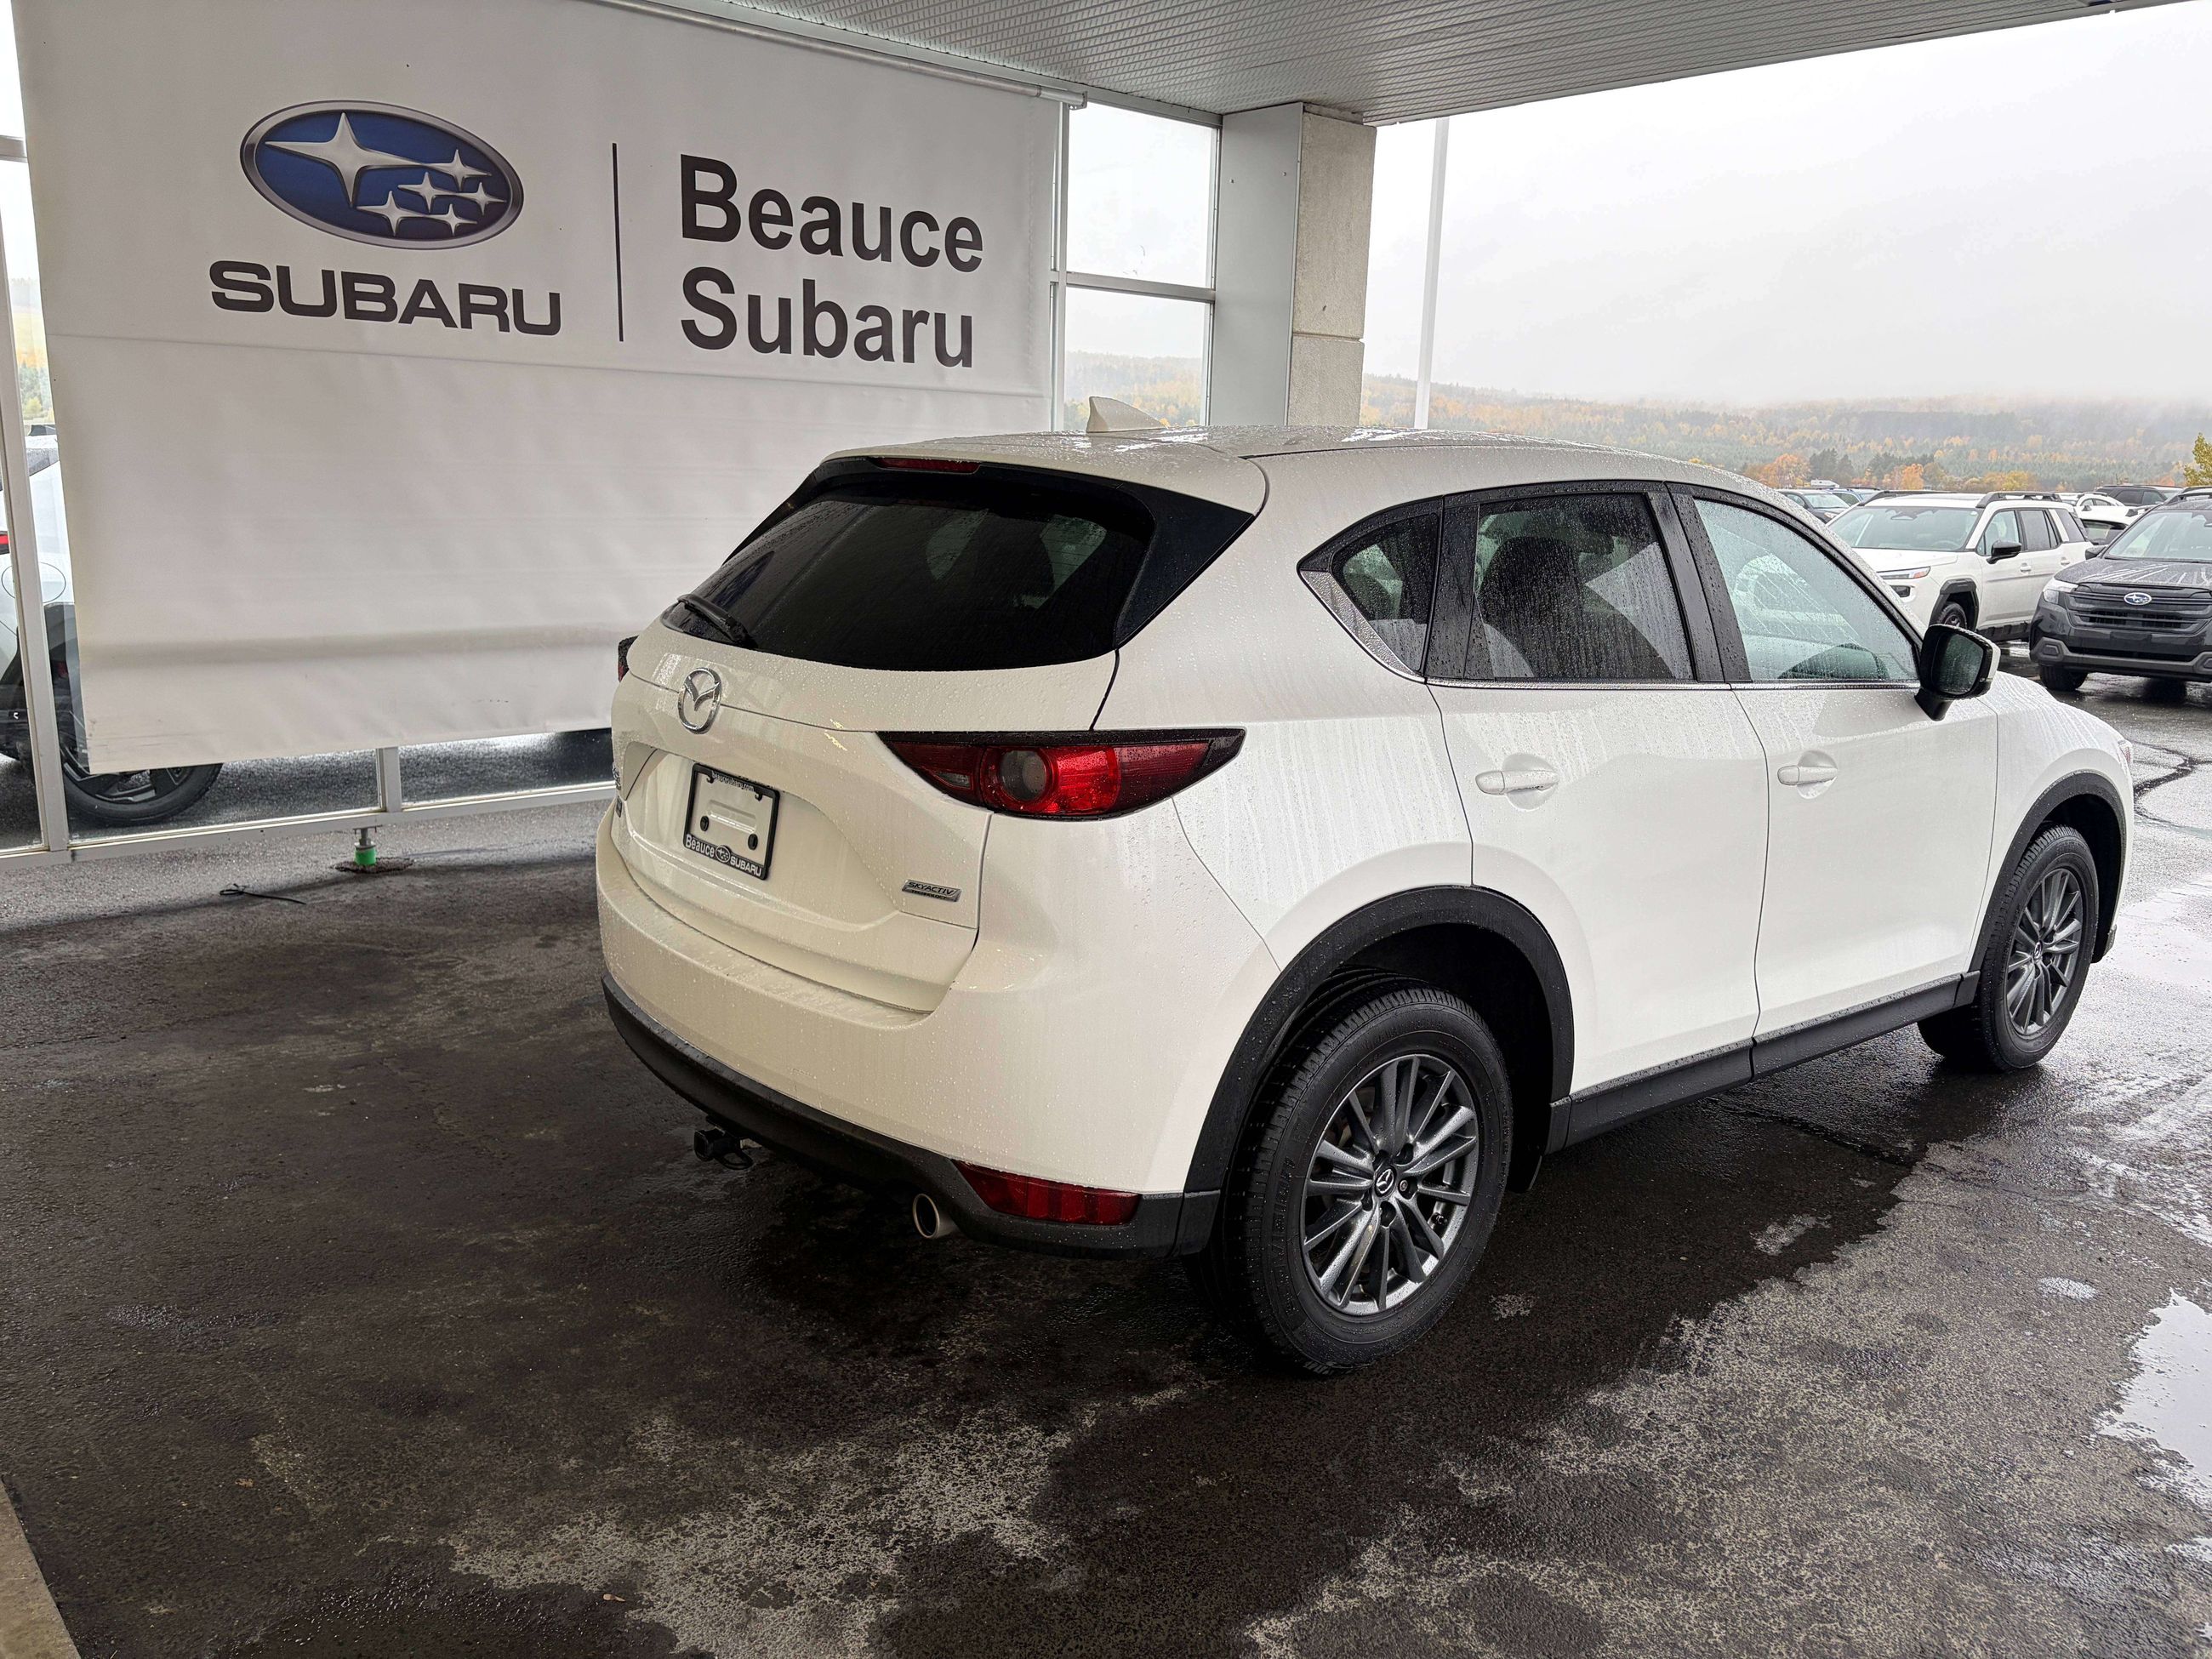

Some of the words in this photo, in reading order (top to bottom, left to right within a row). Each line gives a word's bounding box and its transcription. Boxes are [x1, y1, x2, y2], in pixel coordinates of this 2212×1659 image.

[680, 153, 984, 274] Beauce
[209, 260, 562, 337] SUBARU
[681, 266, 973, 368] Subaru
[685, 834, 715, 858] Beauce
[729, 856, 762, 877] SUBARU
[907, 881, 955, 895] SKYACTIV
